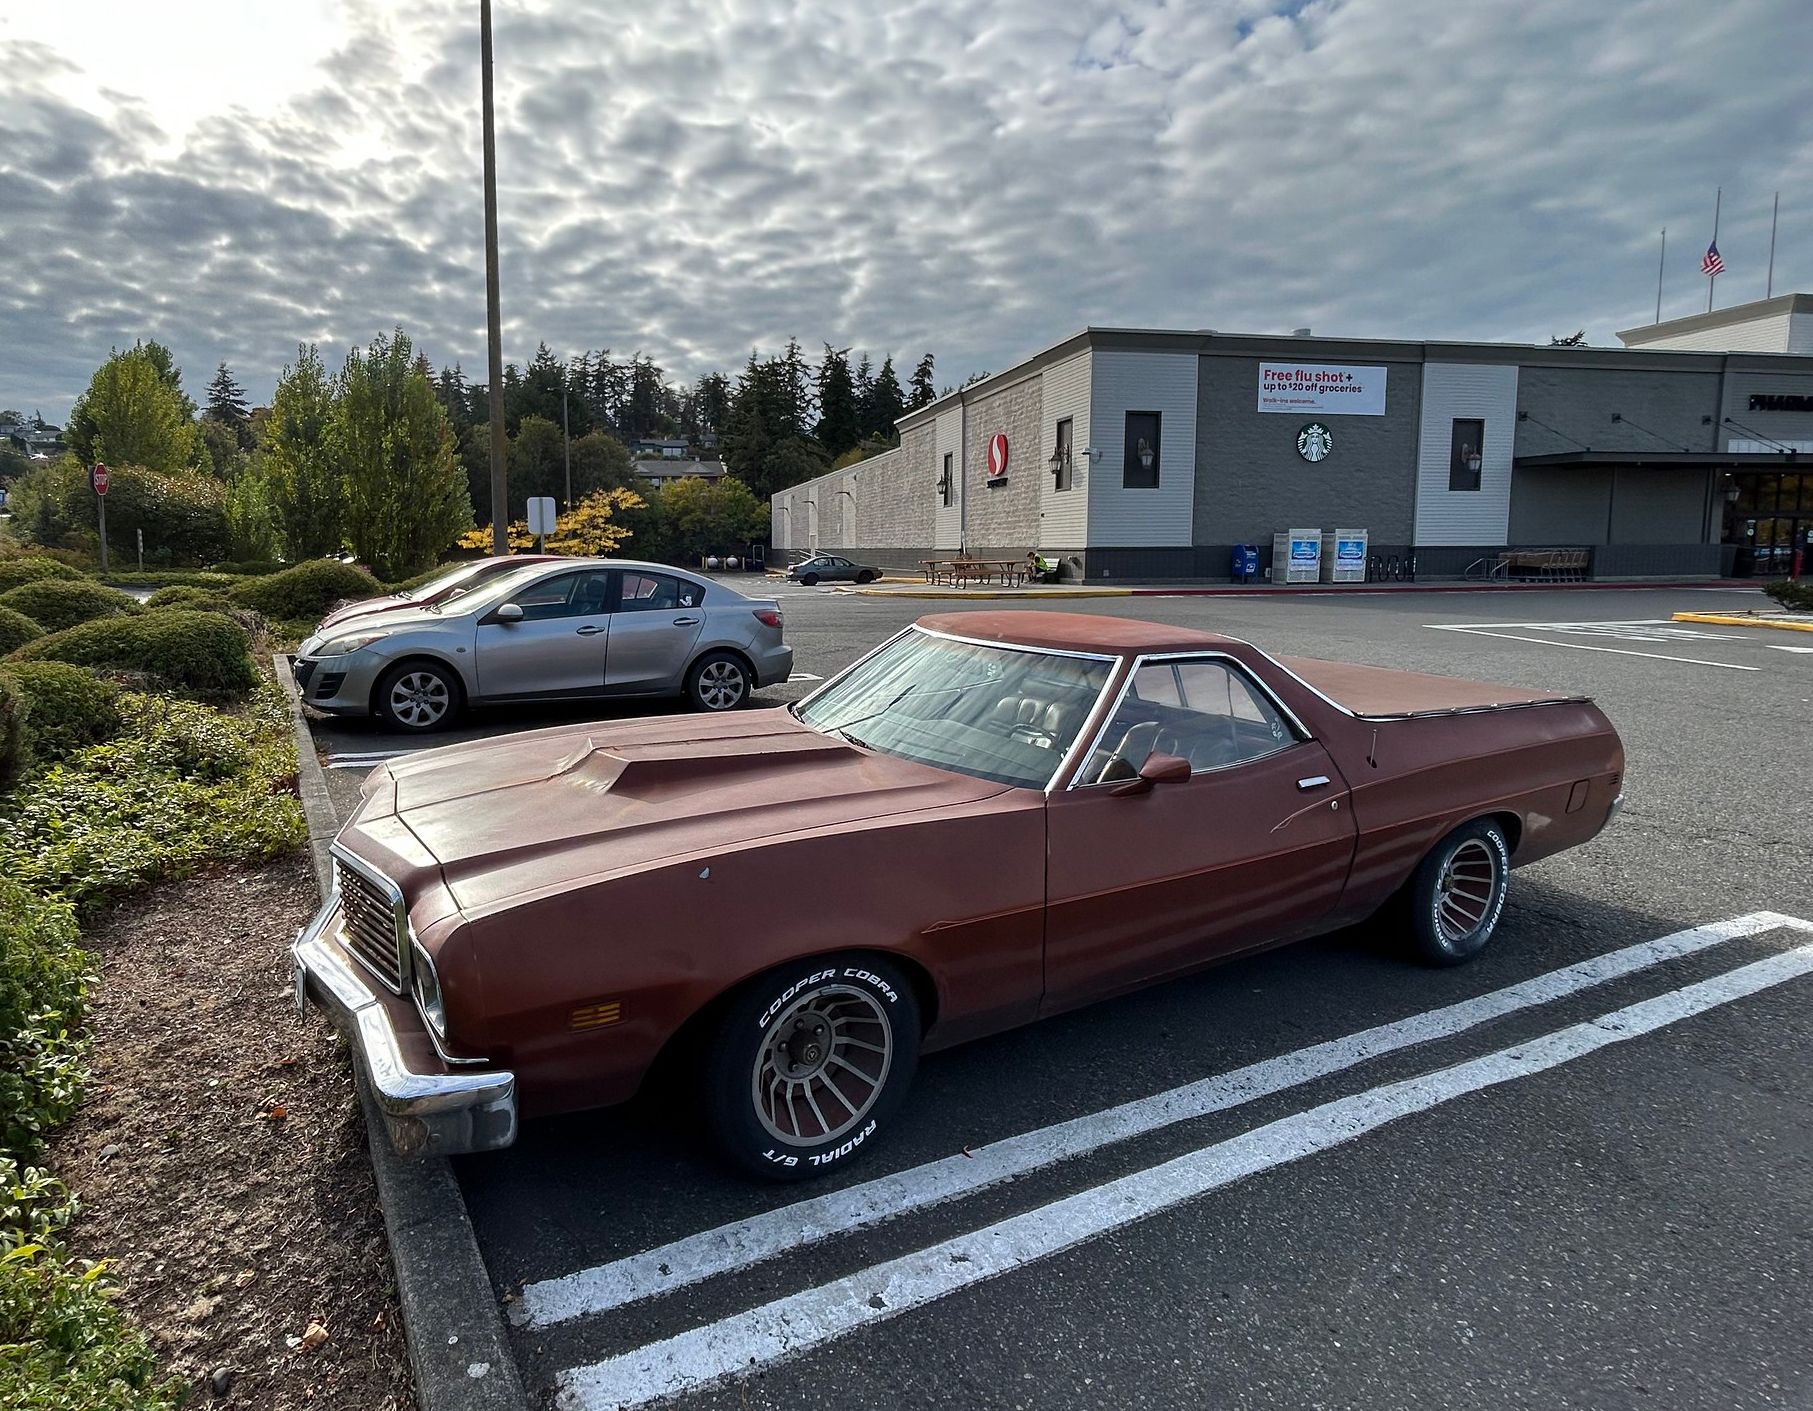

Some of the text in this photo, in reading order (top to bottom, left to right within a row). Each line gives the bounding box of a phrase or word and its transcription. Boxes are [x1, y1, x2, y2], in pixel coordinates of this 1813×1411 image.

[1263, 383, 1276, 392] up
[1278, 382, 1287, 391] to
[1289, 382, 1304, 391] $20
[1305, 383, 1317, 392] off
[1264, 370, 1292, 380] Free
[1295, 370, 1312, 381] flu
[95, 473, 107, 486] STOP
[1487, 830, 1508, 876] COOPER
[759, 968, 898, 1029] COOPER COBRA
[762, 1119, 877, 1167] RADIAL G/T
